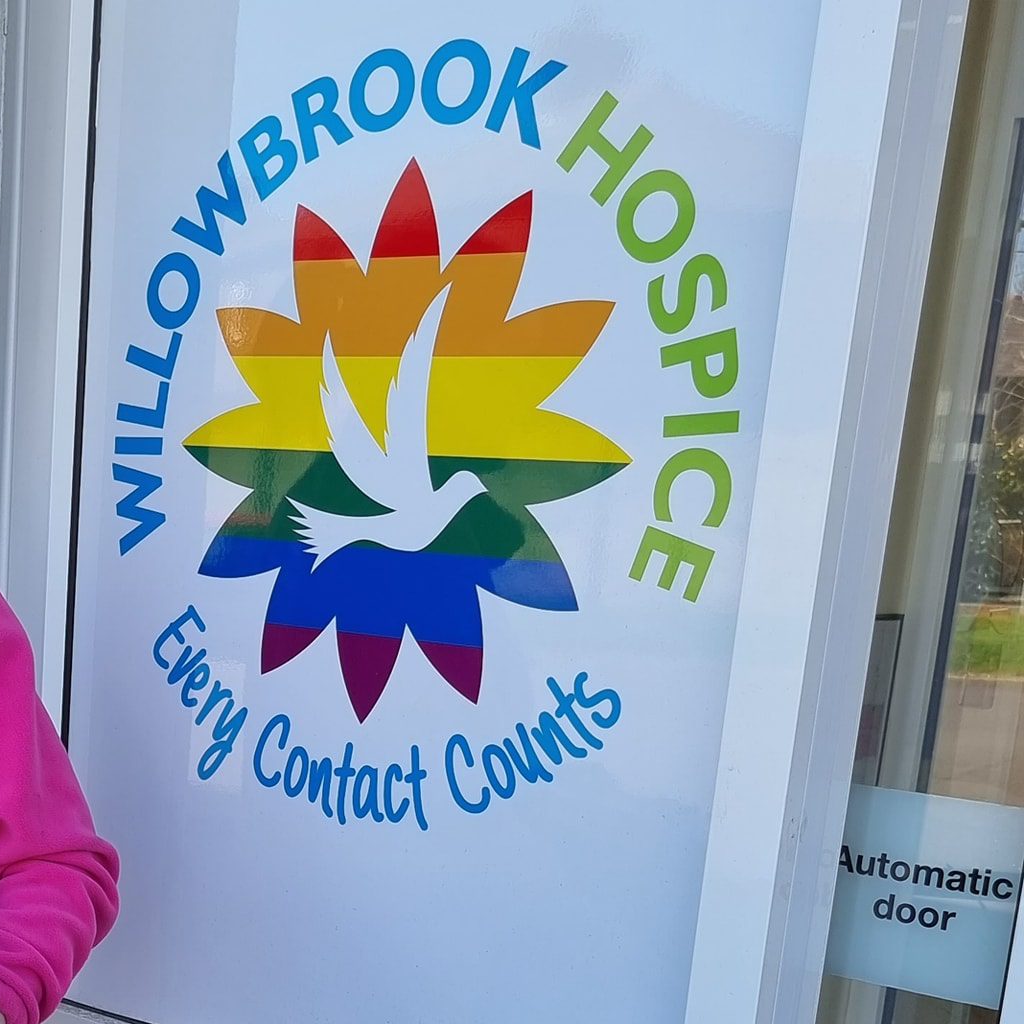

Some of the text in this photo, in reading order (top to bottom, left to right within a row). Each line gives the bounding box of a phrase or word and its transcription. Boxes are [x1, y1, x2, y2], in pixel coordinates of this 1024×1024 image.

[111, 38, 740, 603] WILLOWBROOK HOSPICE
[153, 605, 621, 831] Every Contact Counts
[838, 845, 1014, 900] Automatic
[873, 894, 957, 931] door
